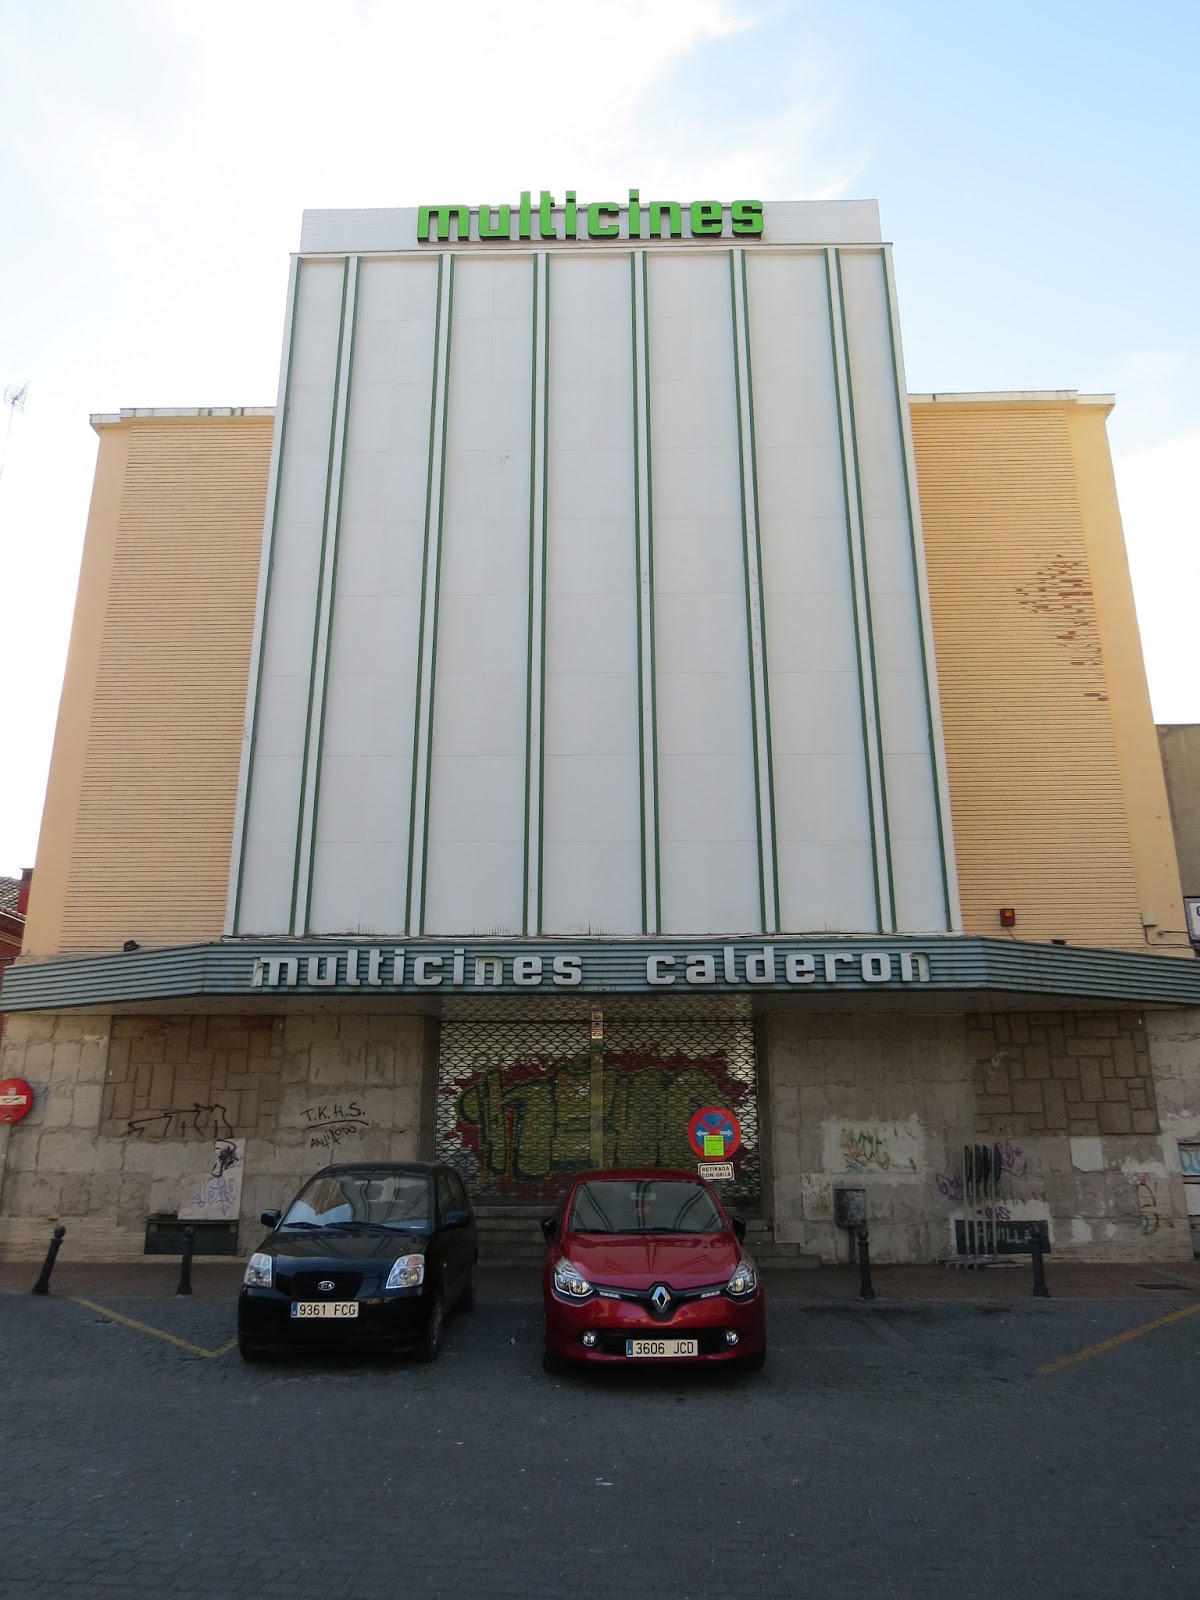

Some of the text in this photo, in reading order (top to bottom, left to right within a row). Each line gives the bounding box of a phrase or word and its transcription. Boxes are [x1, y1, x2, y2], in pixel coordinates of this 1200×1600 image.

[417, 189, 763, 242] multicines
[250, 946, 930, 987] multicines calderon
[299, 1304, 356, 1316] 9361 FCG
[635, 1342, 665, 1355] 3606
[673, 1341, 694, 1354] JCD
